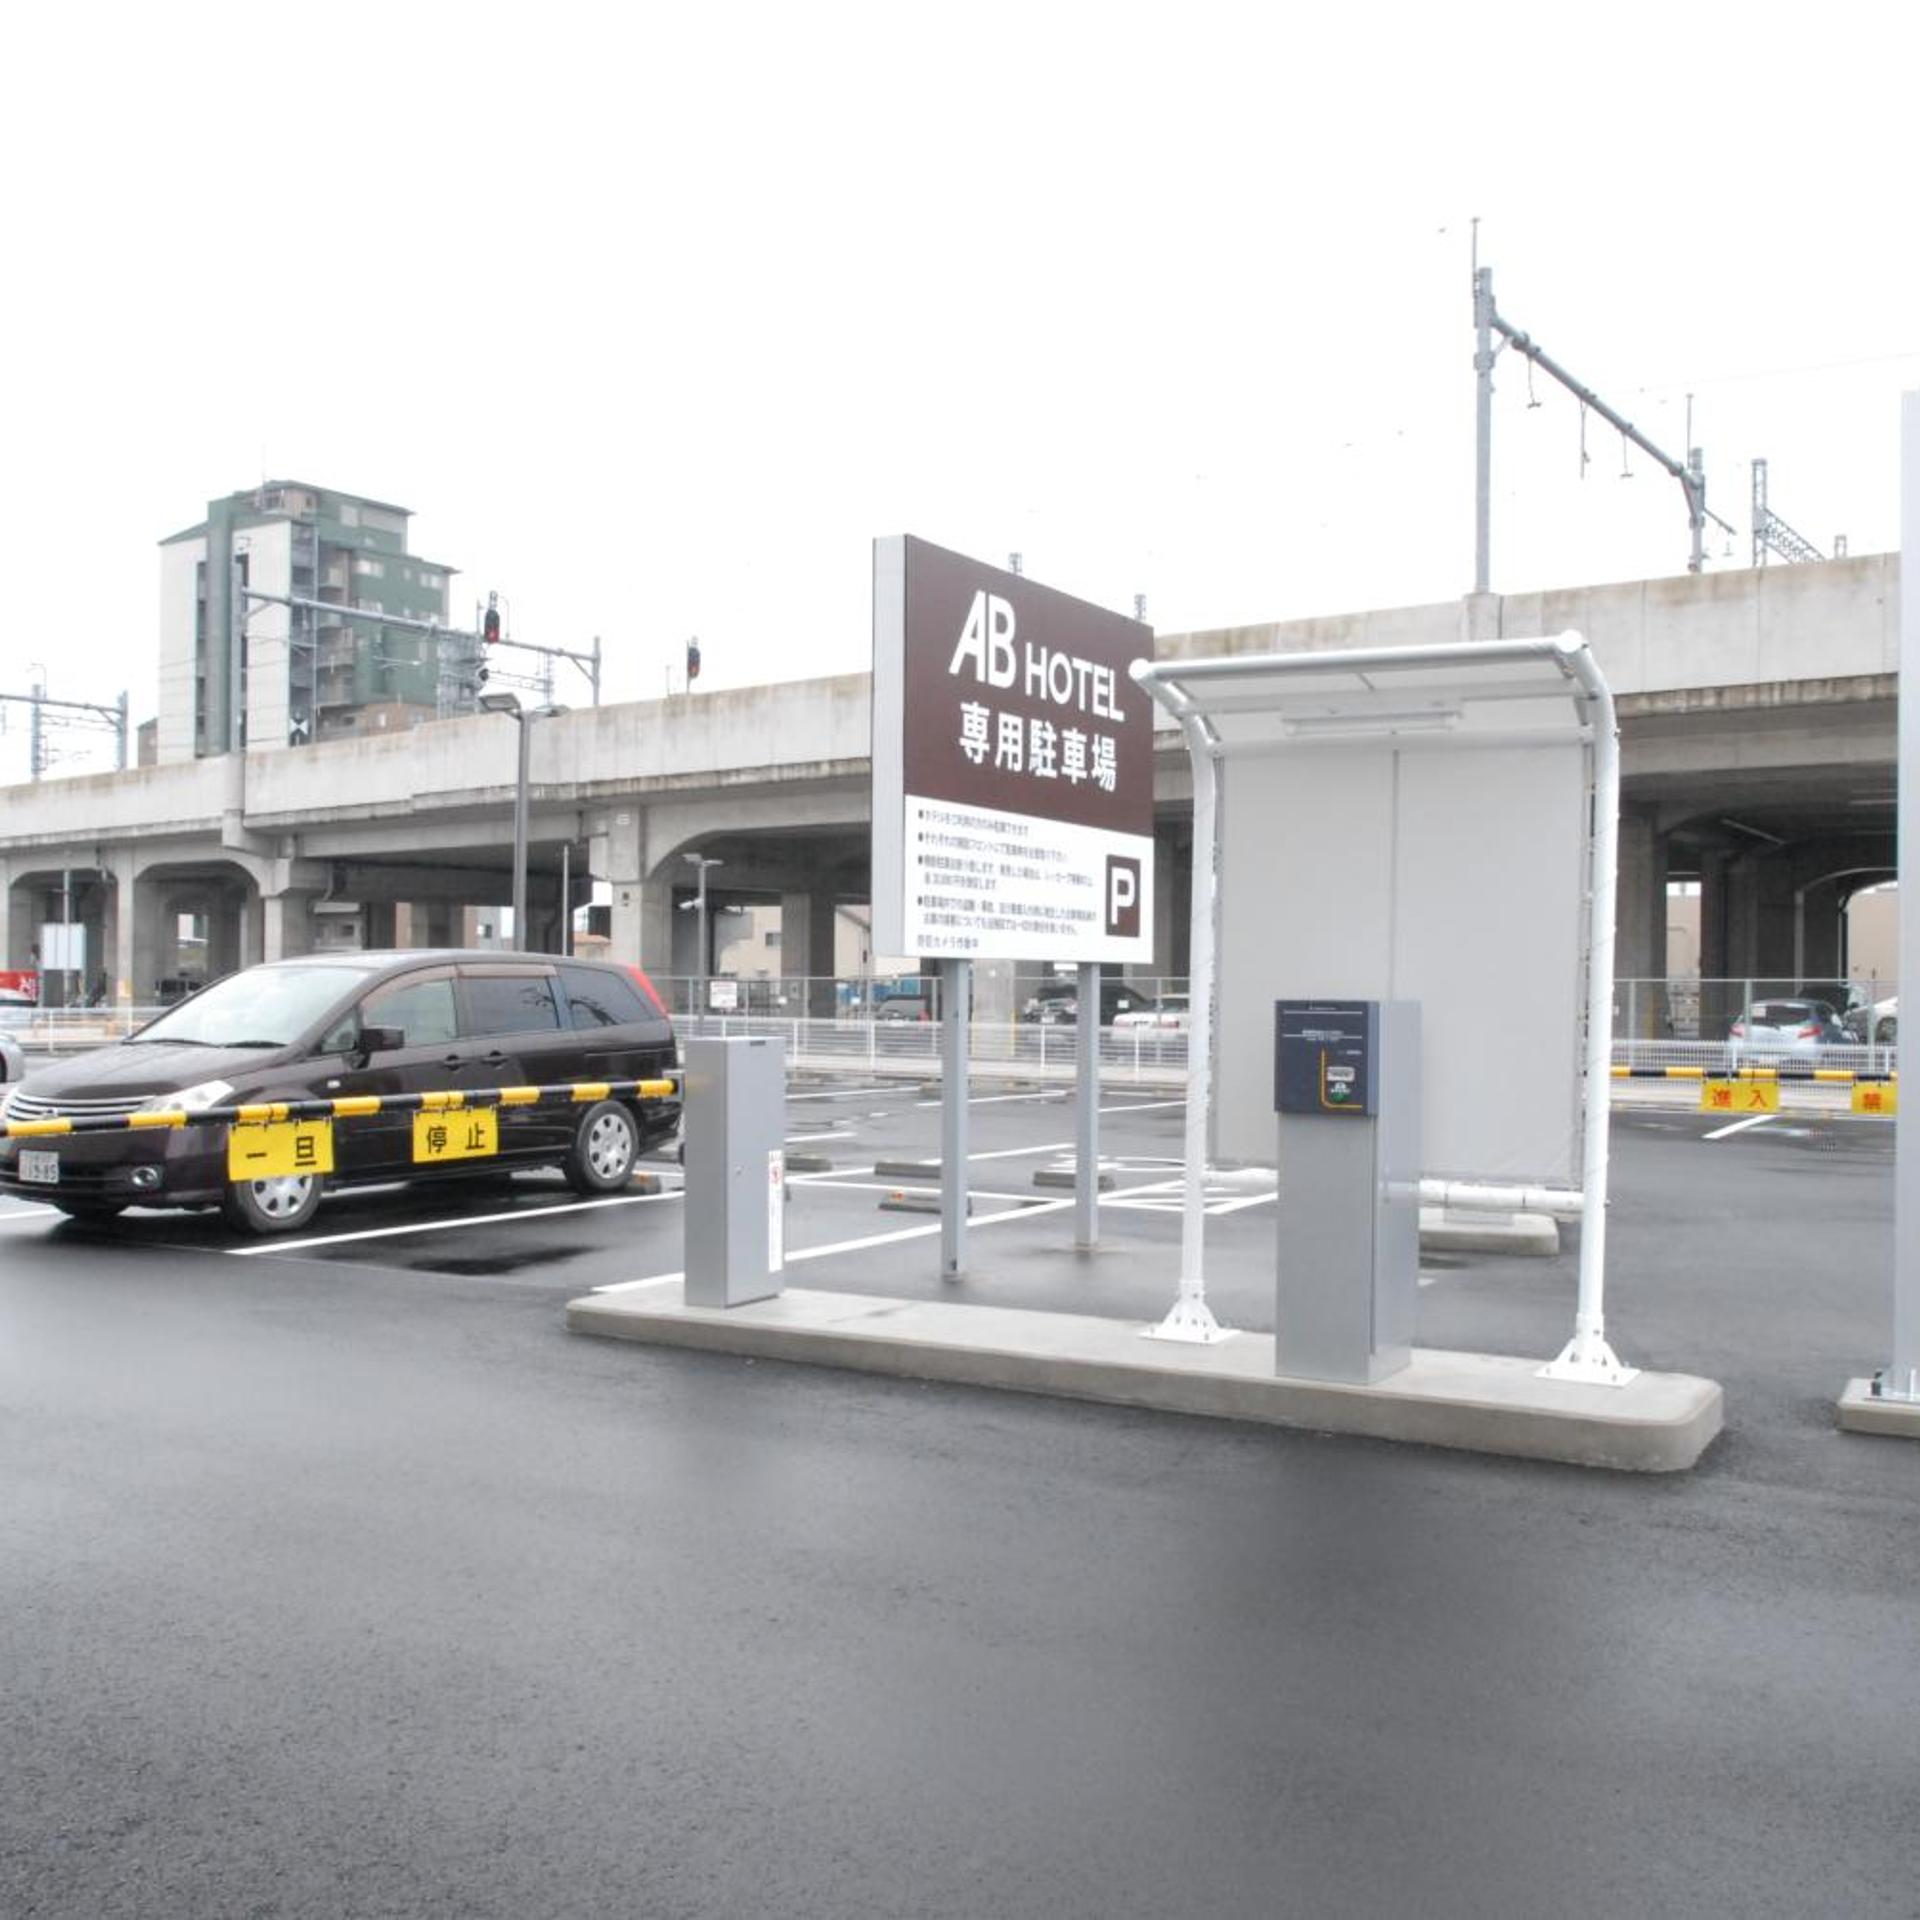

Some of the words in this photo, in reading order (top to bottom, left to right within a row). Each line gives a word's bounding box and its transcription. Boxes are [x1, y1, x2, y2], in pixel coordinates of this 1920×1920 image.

[949, 590, 1016, 689] AB
[1025, 642, 1125, 722] HOTEL
[959, 701, 1117, 792] 専用駐車場
[1111, 866, 1136, 926] P
[246, 1135, 317, 1167] 一旦
[427, 1122, 486, 1154] 停止
